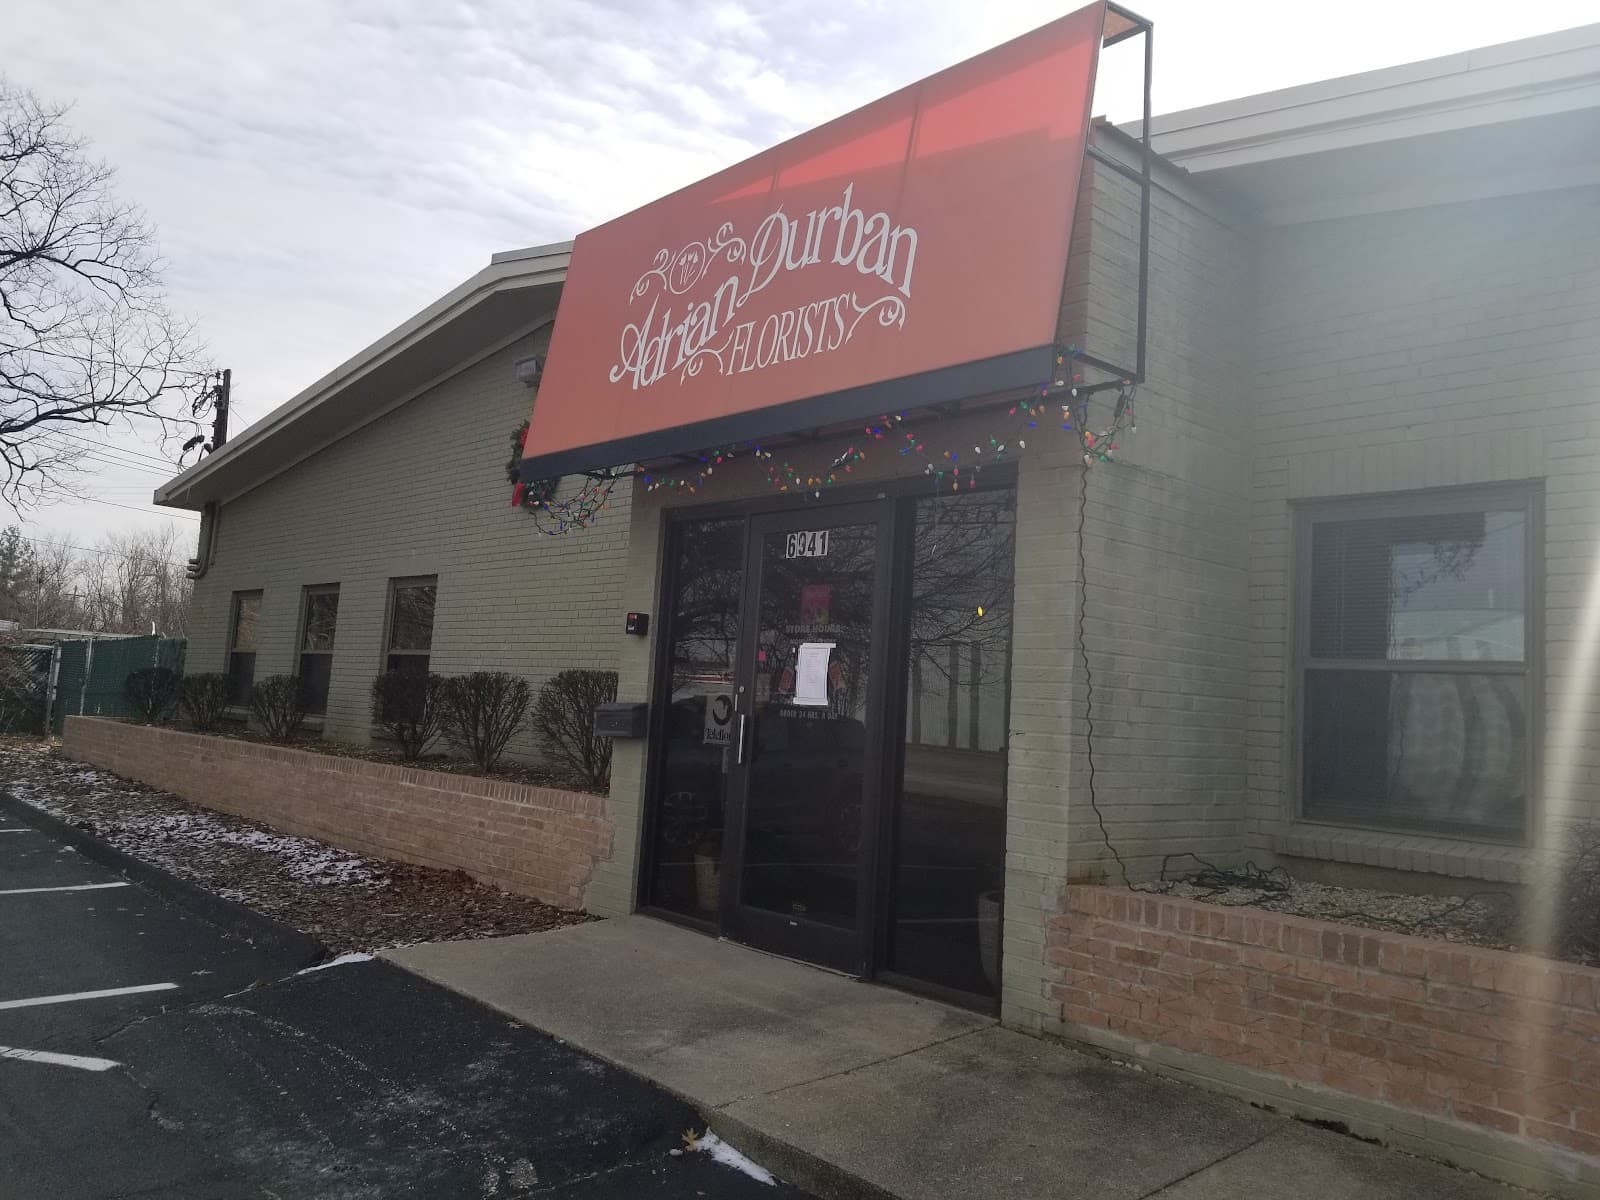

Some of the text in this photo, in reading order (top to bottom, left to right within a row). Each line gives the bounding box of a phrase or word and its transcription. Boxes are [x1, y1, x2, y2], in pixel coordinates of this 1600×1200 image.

[610, 182, 918, 389] Adrian Durban
[727, 292, 852, 376] FLORISTS
[787, 531, 827, 558] 6941
